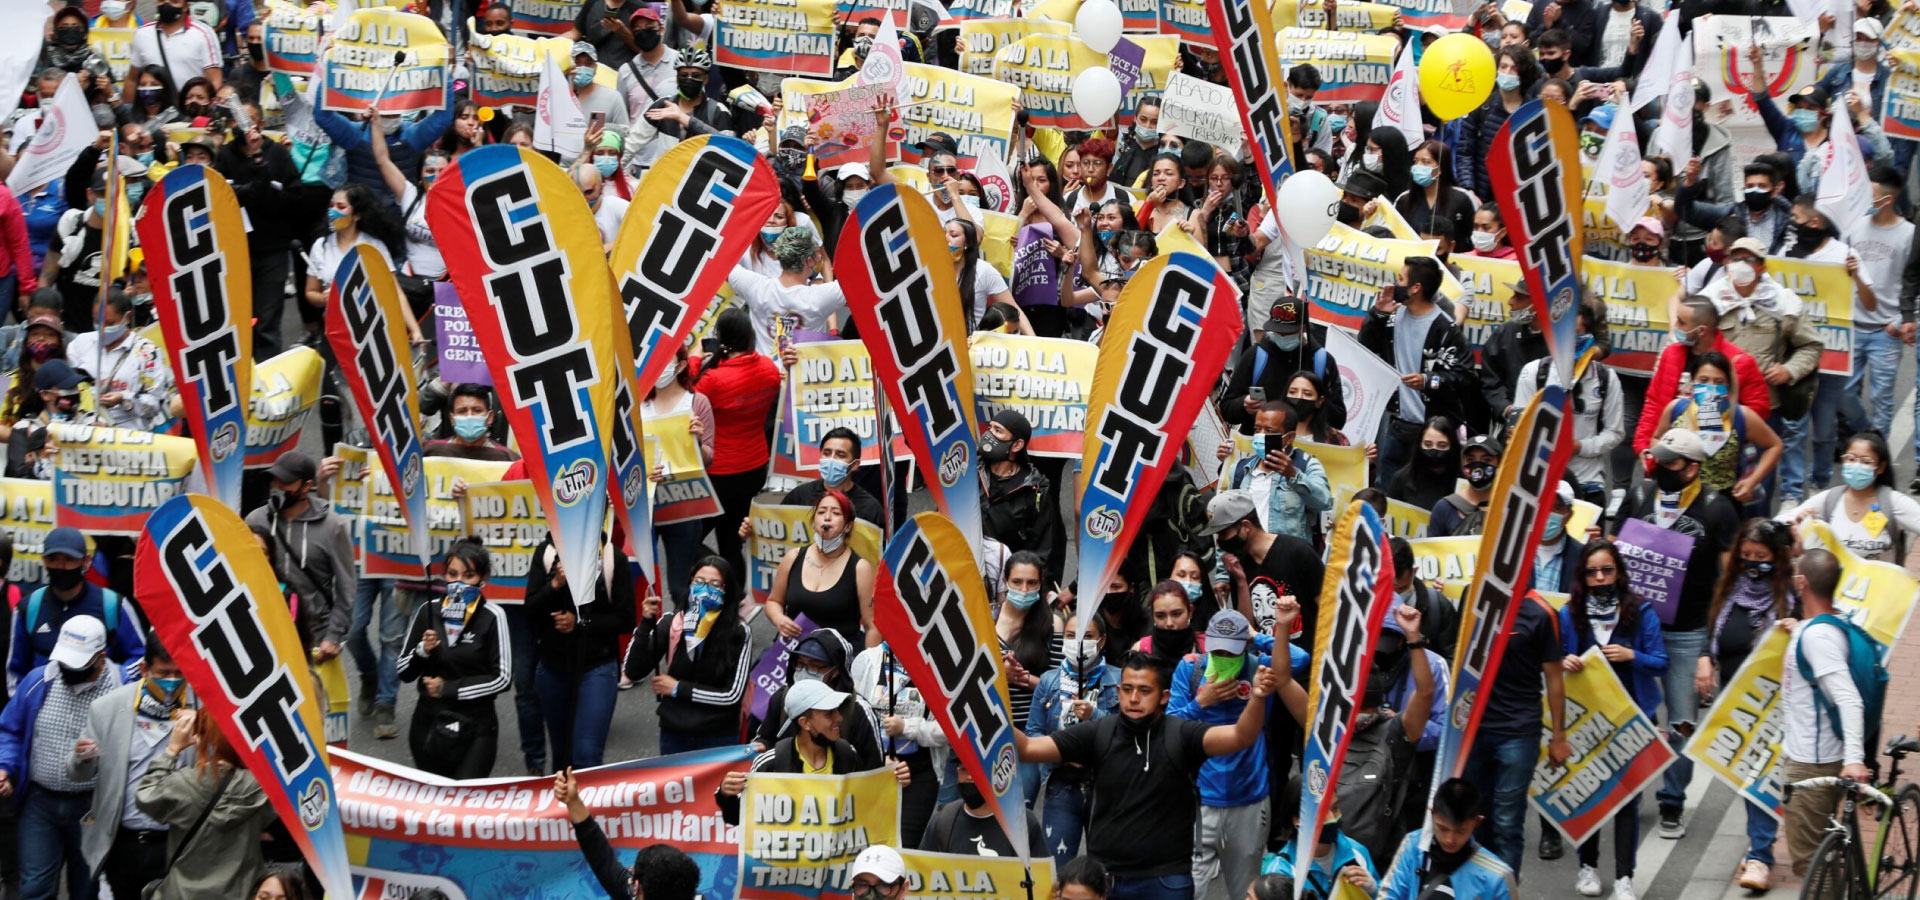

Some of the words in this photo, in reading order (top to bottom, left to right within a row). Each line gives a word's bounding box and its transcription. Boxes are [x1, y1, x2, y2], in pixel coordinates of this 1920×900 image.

[721, 4, 809, 33] REFORMA
[1163, 3, 1211, 28] TRIBU
[1299, 9, 1373, 30] REFRMA
[363, 25, 379, 46] A
[382, 27, 409, 48] LA
[721, 28, 830, 57] TRIBUTARIA
[969, 32, 994, 53] NO
[1003, 44, 1028, 63] NO
[1028, 46, 1043, 66] A
[1045, 49, 1070, 71] LA
[1284, 40, 1366, 62] REFORMA
[475, 72, 541, 97] TRIBUTA
[1000, 67, 1078, 94] REFORM
[1166, 73, 1223, 106] ABAJO
[930, 86, 946, 107] A
[952, 85, 980, 107] LA
[1161, 99, 1226, 132] REFORMA
[1511, 110, 1571, 288] CUT
[622, 147, 748, 361] CUT
[1015, 249, 1050, 271] PODER
[1338, 240, 1355, 256] A
[1359, 242, 1389, 264] LA
[1015, 274, 1049, 295] GENTE
[1019, 266, 1032, 280] DE
[1031, 262, 1047, 275] LA
[164, 182, 239, 416] CUT
[1609, 276, 1638, 300] LA
[1790, 275, 1817, 297] LA
[469, 165, 596, 449] CUT
[863, 201, 958, 440] CUT
[444, 347, 484, 362] GENT
[449, 335, 470, 347] DE
[342, 259, 413, 456] CUT
[802, 358, 834, 383] NO
[840, 357, 857, 381] A
[858, 356, 874, 380] L
[975, 346, 1005, 369] NO
[1013, 347, 1030, 369] A
[1034, 350, 1067, 374] LA
[972, 371, 1080, 402] REFORMA
[1097, 267, 1211, 497] CUT
[802, 386, 876, 412] REFOR
[59, 422, 93, 443] NO
[99, 426, 115, 445] A
[123, 427, 155, 445] LA
[60, 446, 170, 477] REFORMA
[11, 496, 30, 520] A
[471, 495, 506, 519] NO
[512, 495, 530, 517] A
[475, 521, 552, 547] REFOR
[755, 519, 787, 542] NO
[793, 520, 809, 541] A
[1466, 405, 1562, 678] CUT
[1445, 554, 1462, 578] A
[1666, 555, 1689, 572] EL
[1645, 573, 1668, 590] LA
[164, 514, 312, 777] CUT
[896, 534, 1008, 753] CUT
[1313, 521, 1381, 758] CUT
[1705, 726, 1741, 767] NO
[1730, 707, 1757, 732] A
[1744, 674, 1781, 710] LA
[1546, 719, 1657, 817] TRIBUTARIA
[347, 768, 532, 809] democracia
[534, 786, 557, 813] y
[663, 776, 695, 803] el
[753, 793, 793, 824] NO
[800, 795, 819, 823] A
[825, 793, 856, 823] LA
[402, 811, 421, 835] y
[426, 809, 455, 837] la
[594, 809, 741, 846] tributaria
[752, 825, 869, 862] REFORMA
[929, 870, 951, 893] A
[954, 870, 995, 894] LA
